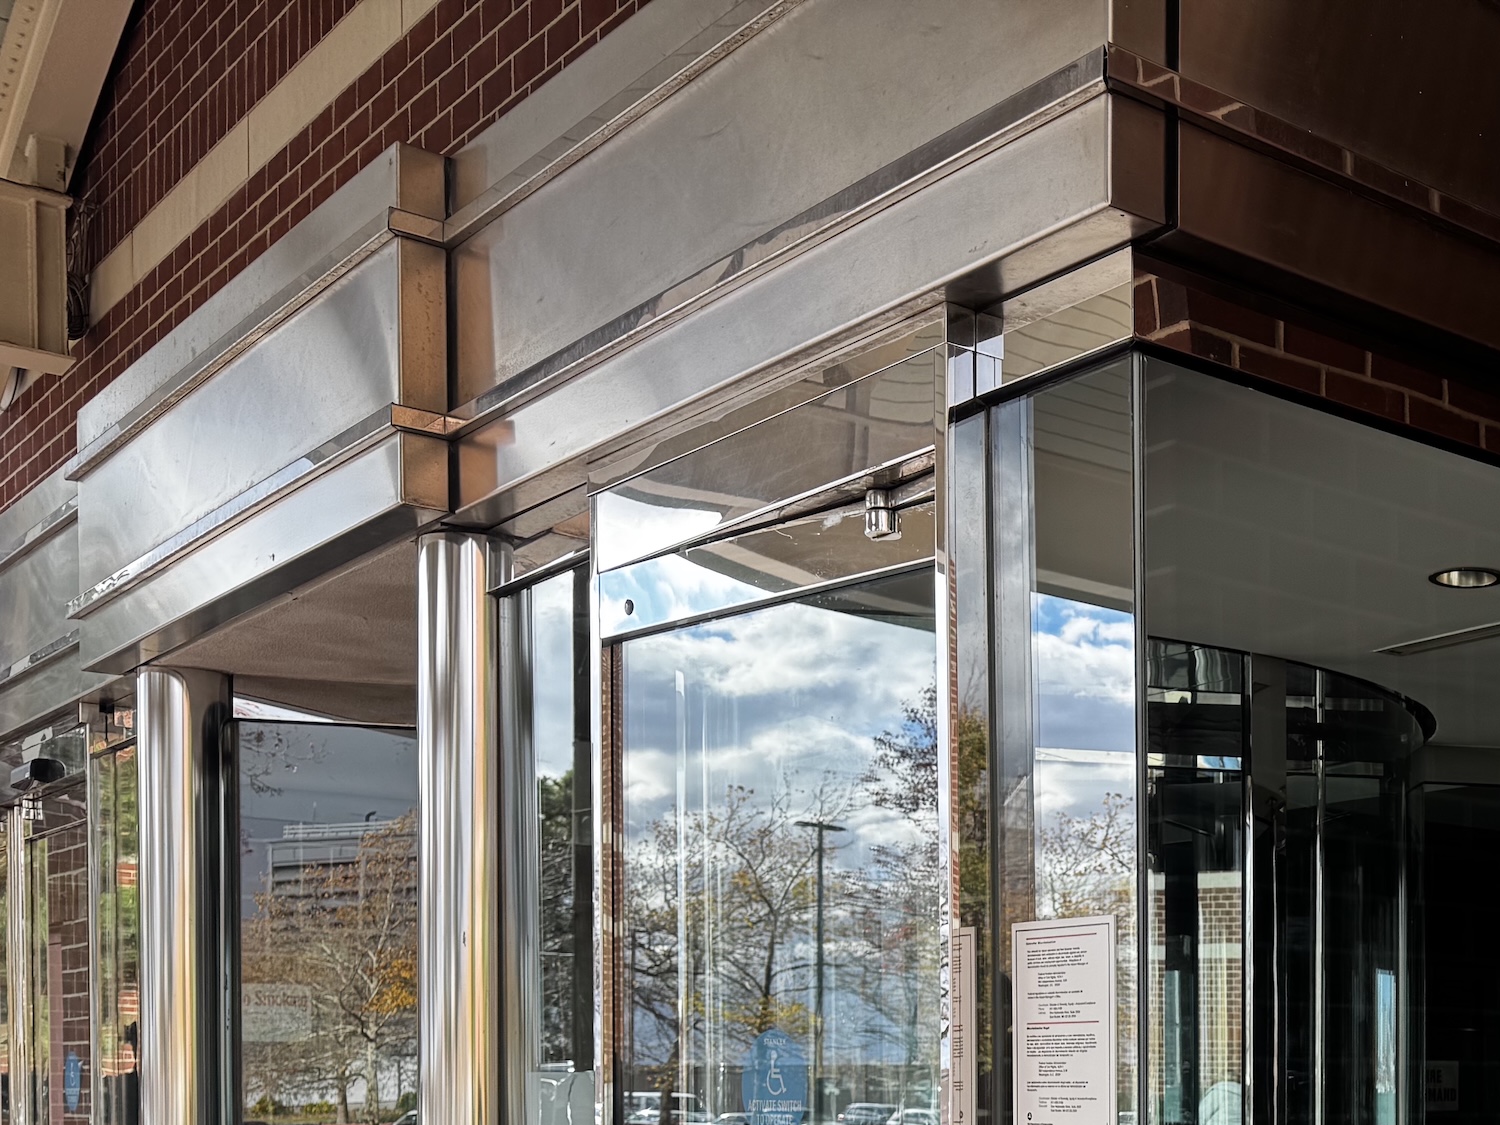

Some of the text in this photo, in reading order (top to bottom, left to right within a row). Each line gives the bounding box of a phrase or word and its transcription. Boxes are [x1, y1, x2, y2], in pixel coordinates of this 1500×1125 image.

[748, 1099, 802, 1112] ACTIVATE SWITCH
[756, 1114, 793, 1125] TO OPERATE
